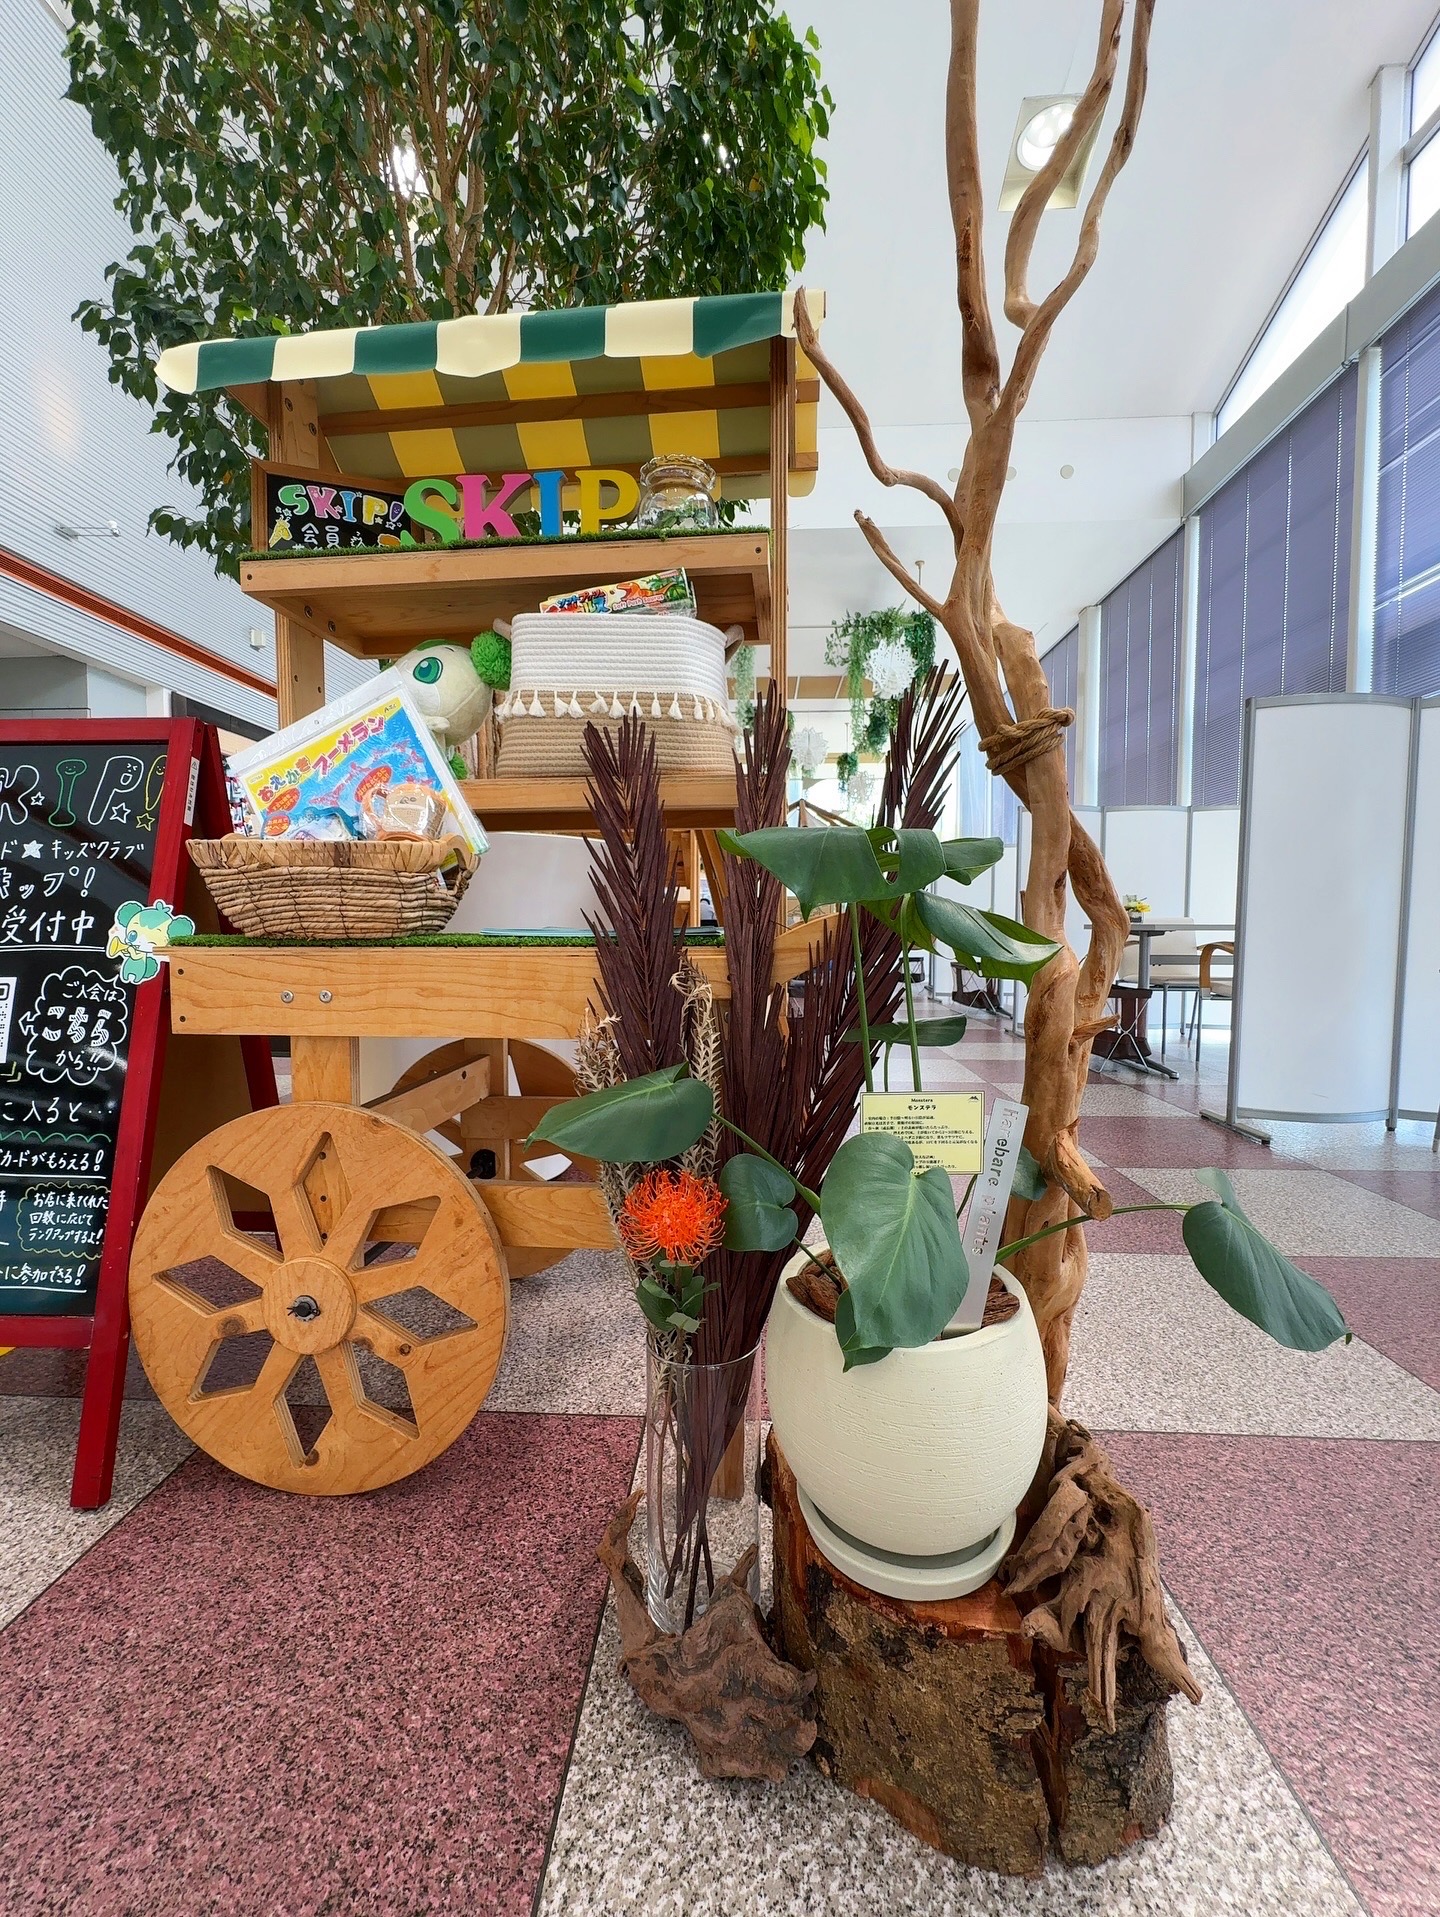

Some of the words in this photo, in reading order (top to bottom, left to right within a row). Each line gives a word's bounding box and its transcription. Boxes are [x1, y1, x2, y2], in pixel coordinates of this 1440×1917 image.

[401, 469, 641, 546] SKIP
[62, 981, 118, 1002] ご入会は
[42, 1006, 112, 1047] こちら
[0, 1149, 104, 1171] カードがもらえる!
[33, 1191, 109, 1209] お店に来てくれた
[29, 1211, 93, 1226] 回数に応じて
[0, 1263, 86, 1285] に参加できる!
